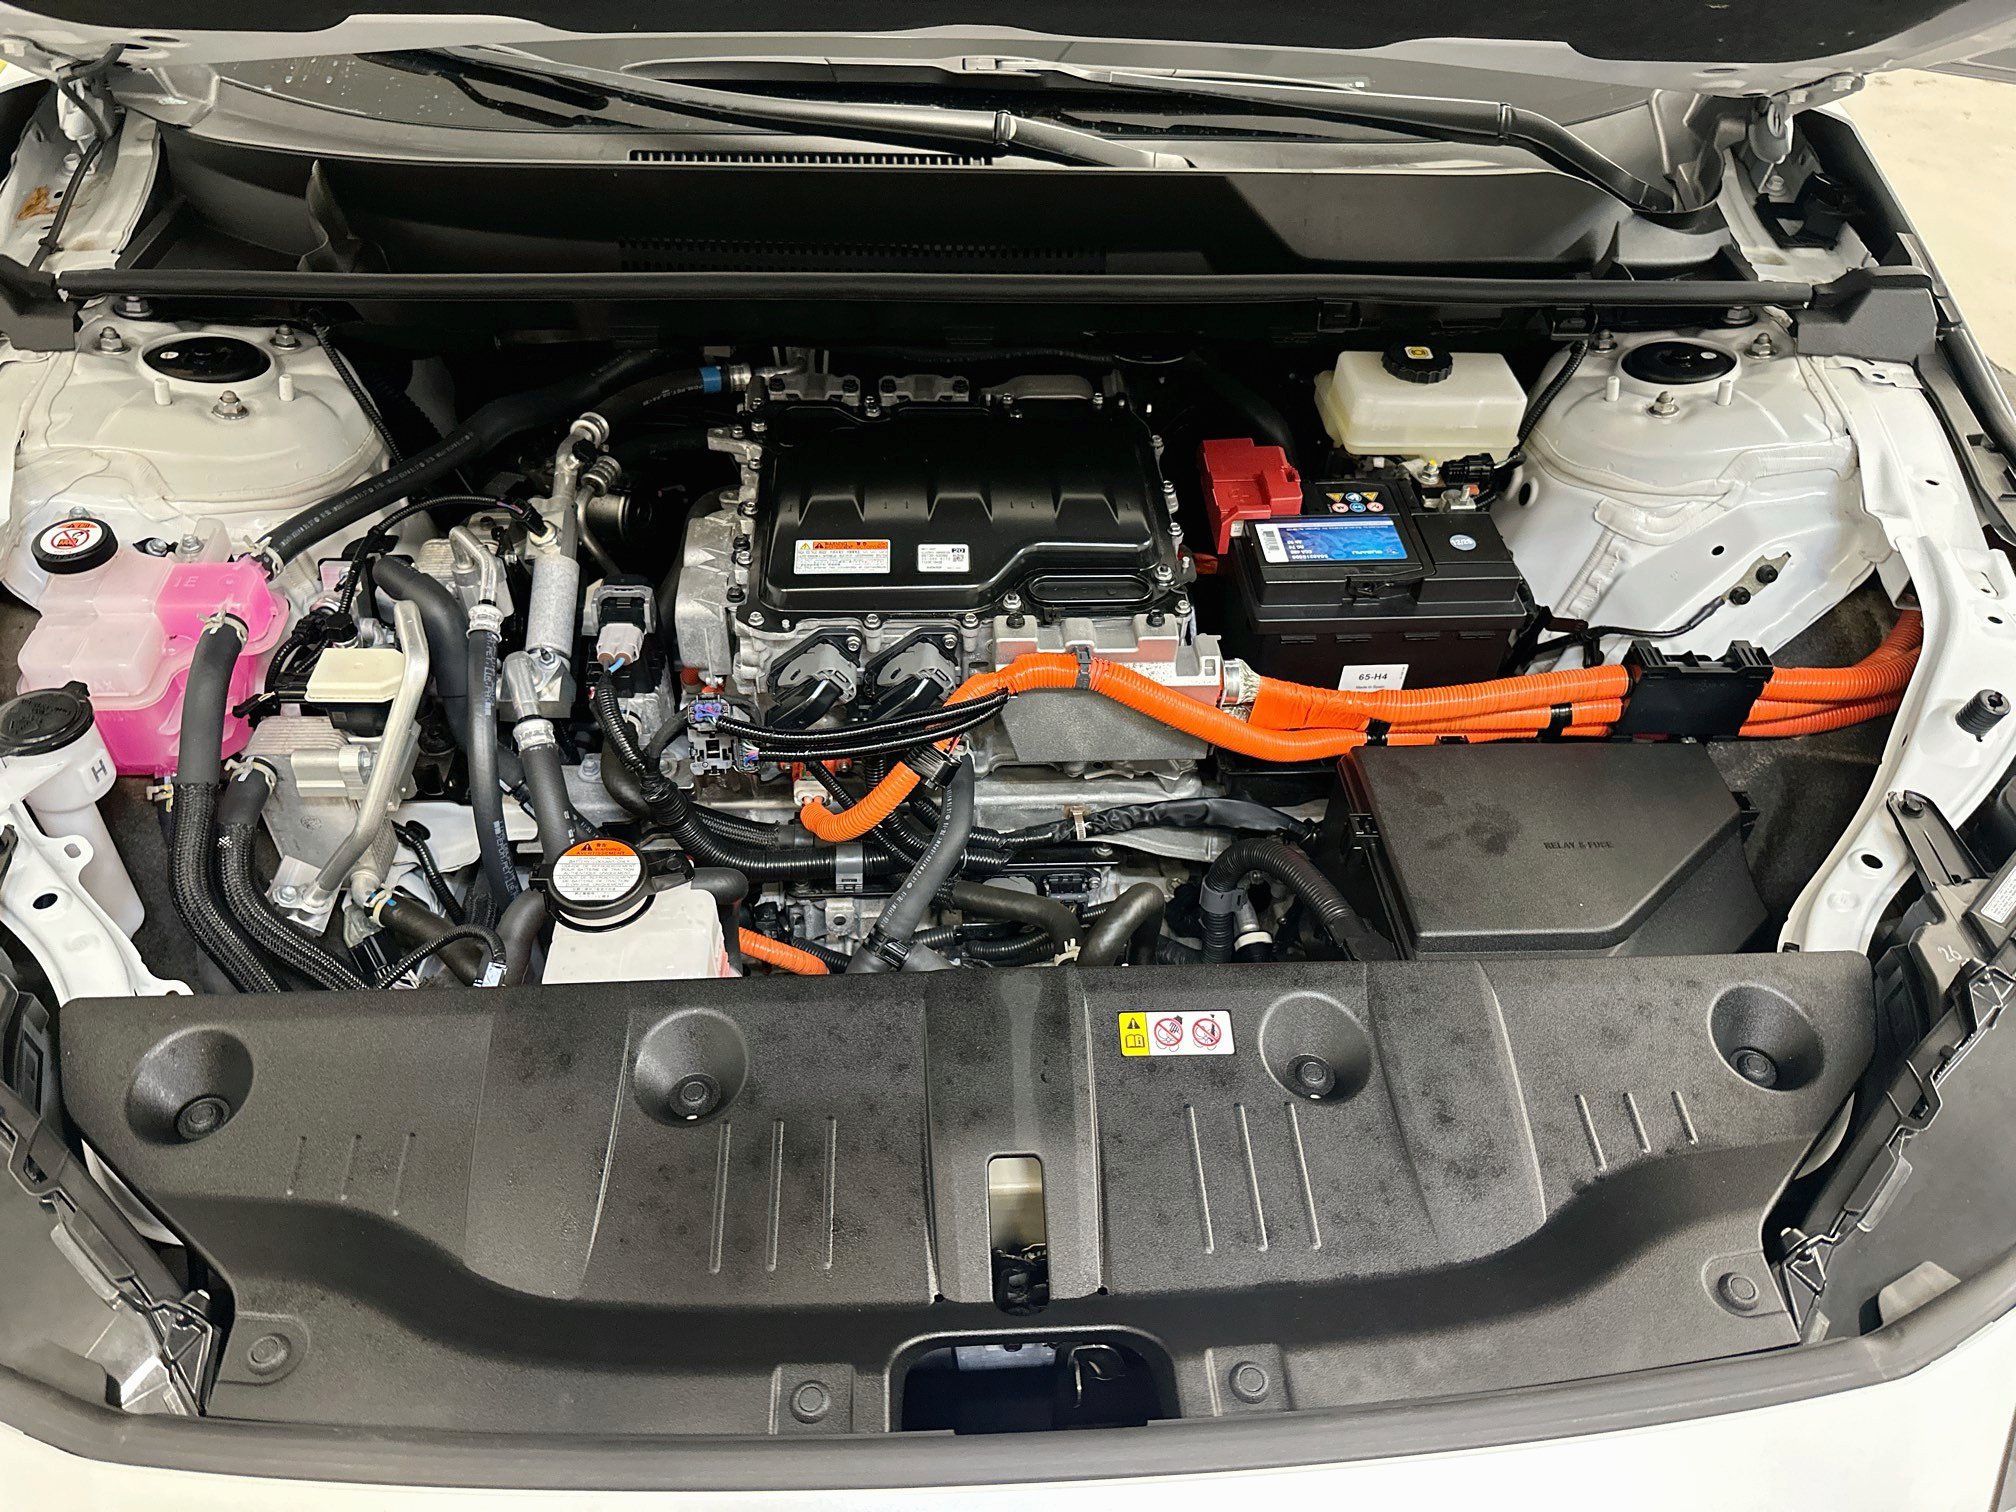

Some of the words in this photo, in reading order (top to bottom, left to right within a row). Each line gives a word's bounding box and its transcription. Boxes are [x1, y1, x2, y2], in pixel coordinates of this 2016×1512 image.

[1358, 673, 1388, 681] 65-H4
[91, 760, 107, 783] H
[1543, 841, 1575, 850] RELAY
[1937, 944, 1963, 963] 26
